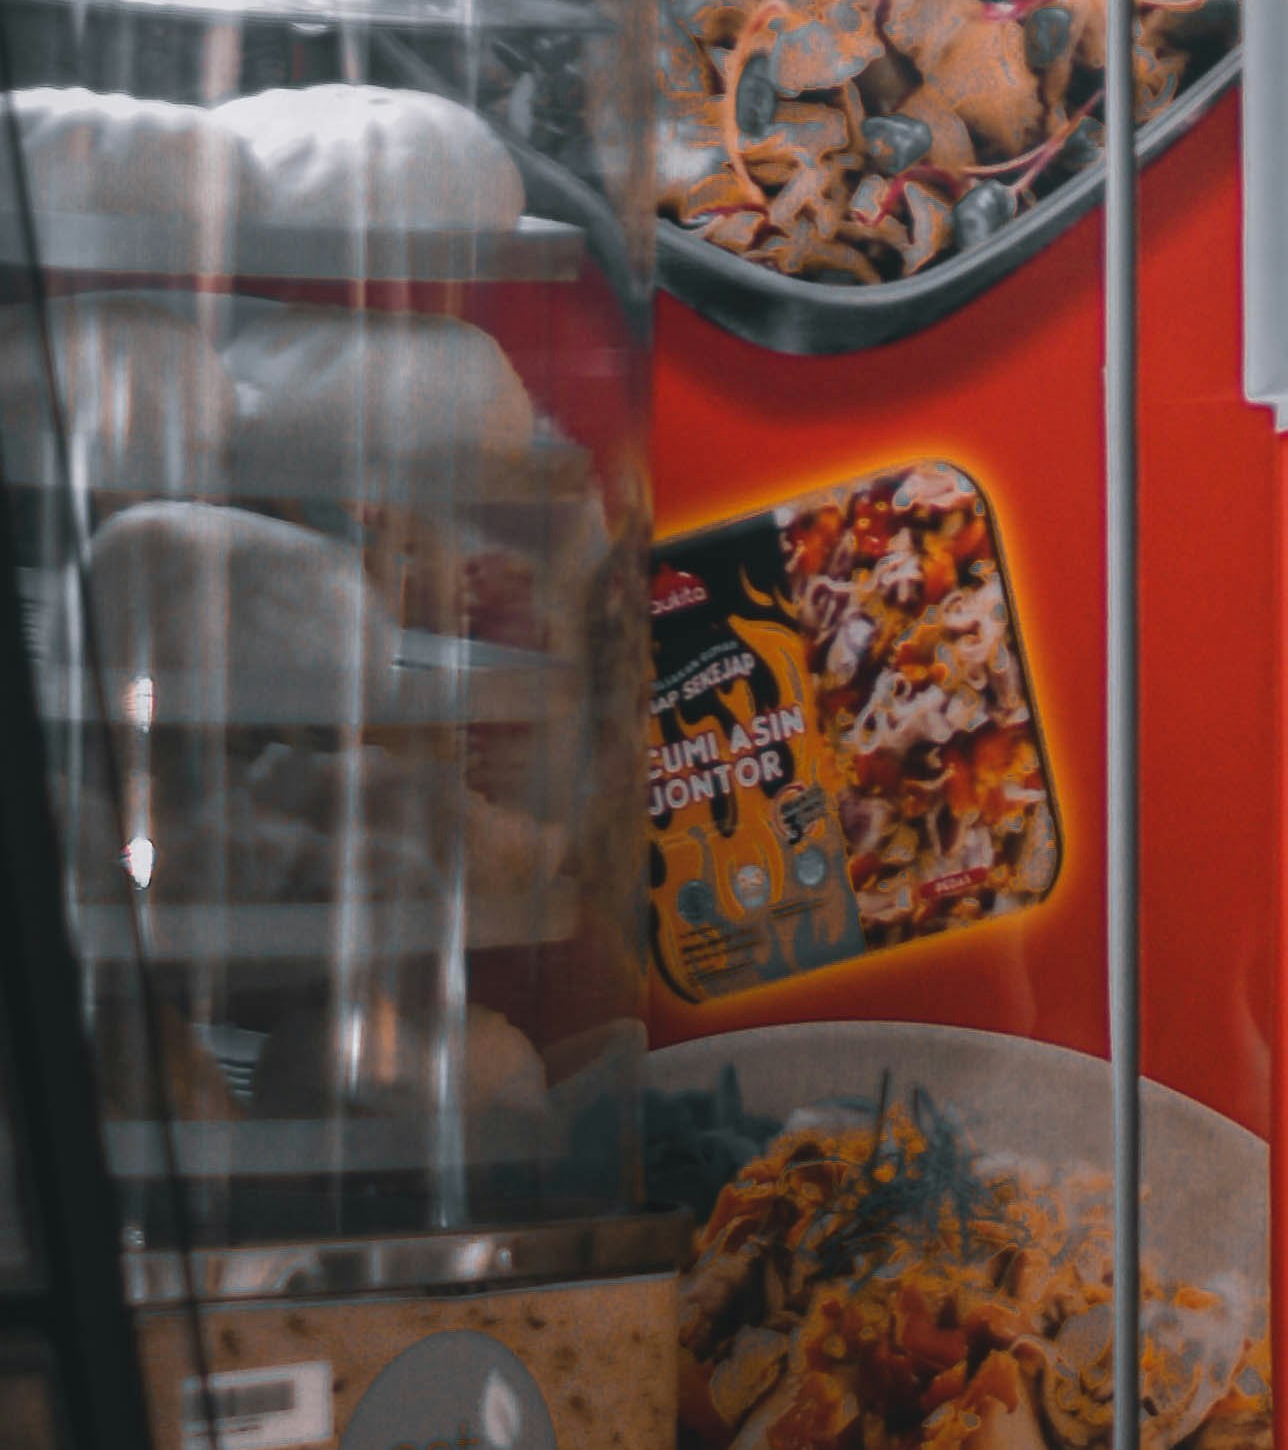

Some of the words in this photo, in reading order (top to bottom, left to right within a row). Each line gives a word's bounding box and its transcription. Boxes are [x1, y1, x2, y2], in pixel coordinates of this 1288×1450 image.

[682, 652, 757, 701] SEKEJAP
[730, 705, 805, 753] ASIN
[649, 751, 784, 816] JONTOR
